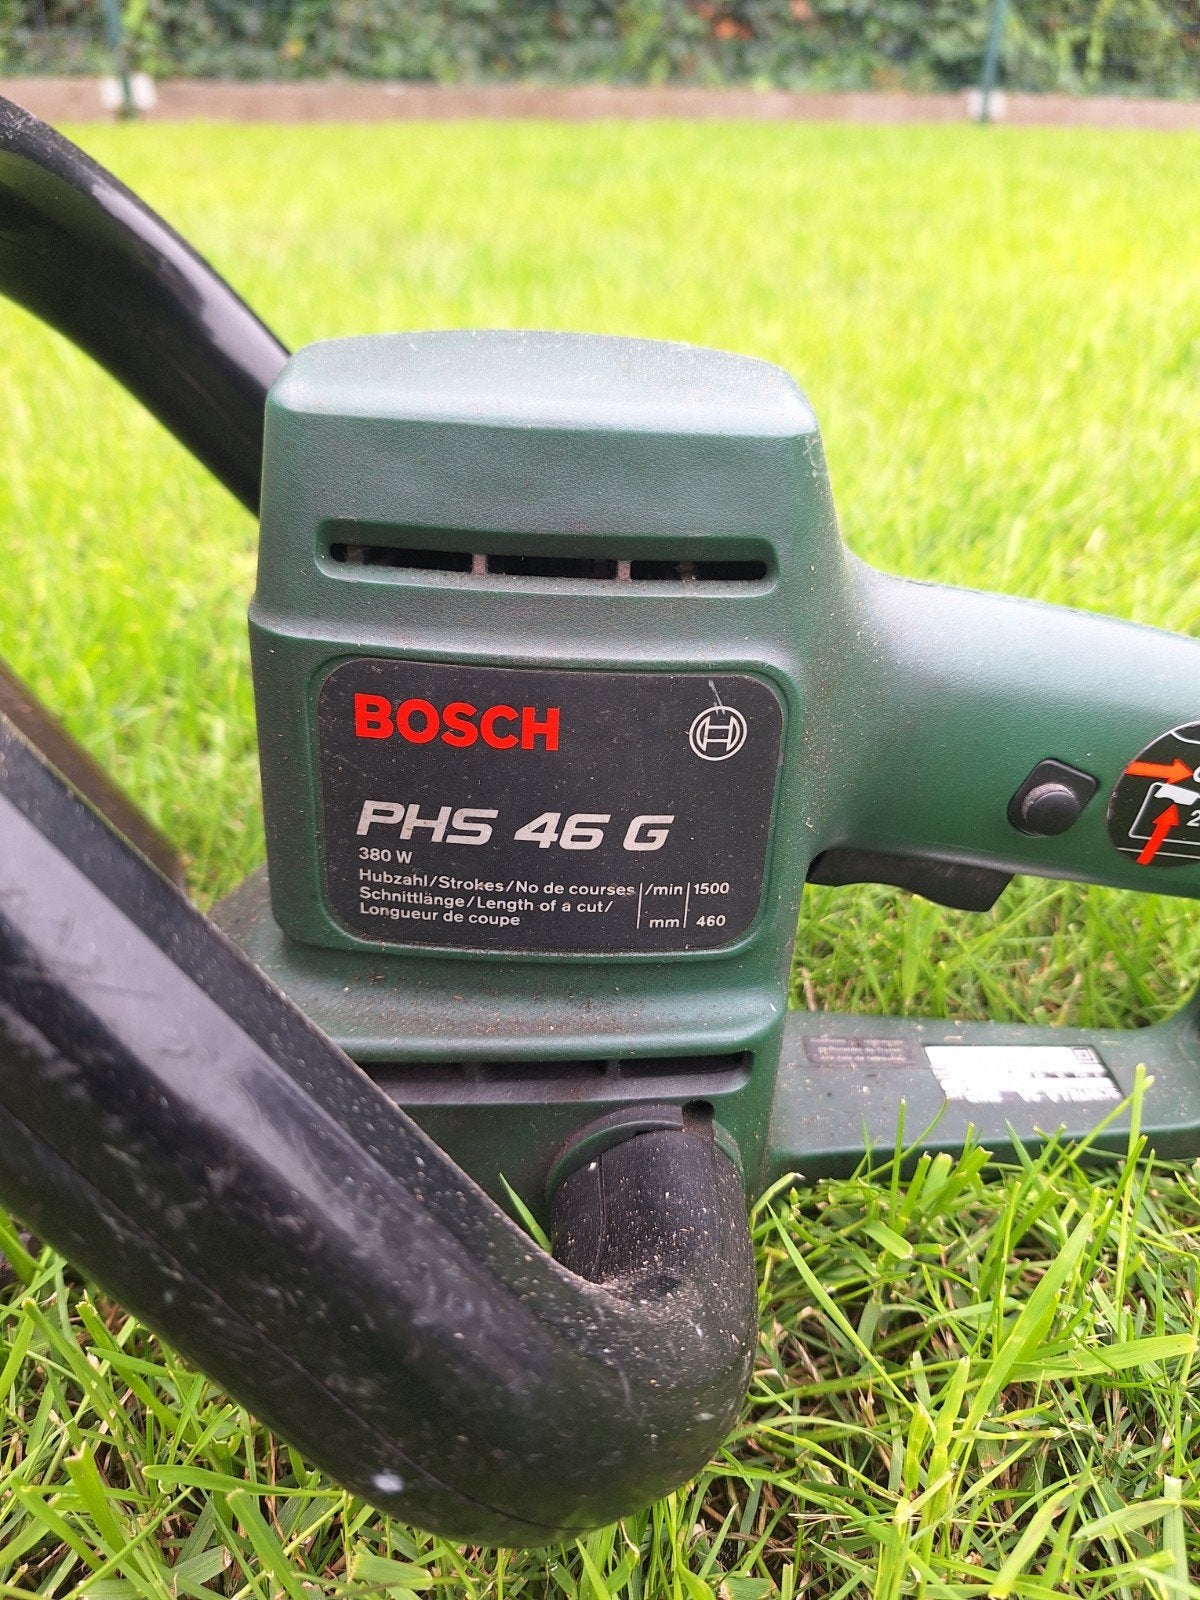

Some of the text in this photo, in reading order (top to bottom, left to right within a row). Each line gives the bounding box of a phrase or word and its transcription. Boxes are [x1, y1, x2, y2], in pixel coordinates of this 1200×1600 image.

[354, 693, 560, 751] BOSCH
[356, 800, 674, 851] PHS 46 G
[359, 847, 413, 864] 380 W
[359, 887, 614, 913] Schnittlänge/Length of a cut/
[543, 881, 564, 895] de
[568, 883, 635, 896] courses
[645, 883, 683, 896] /min
[694, 882, 730, 895] 1500
[360, 903, 726, 929] Longueur de coupe mm 460
